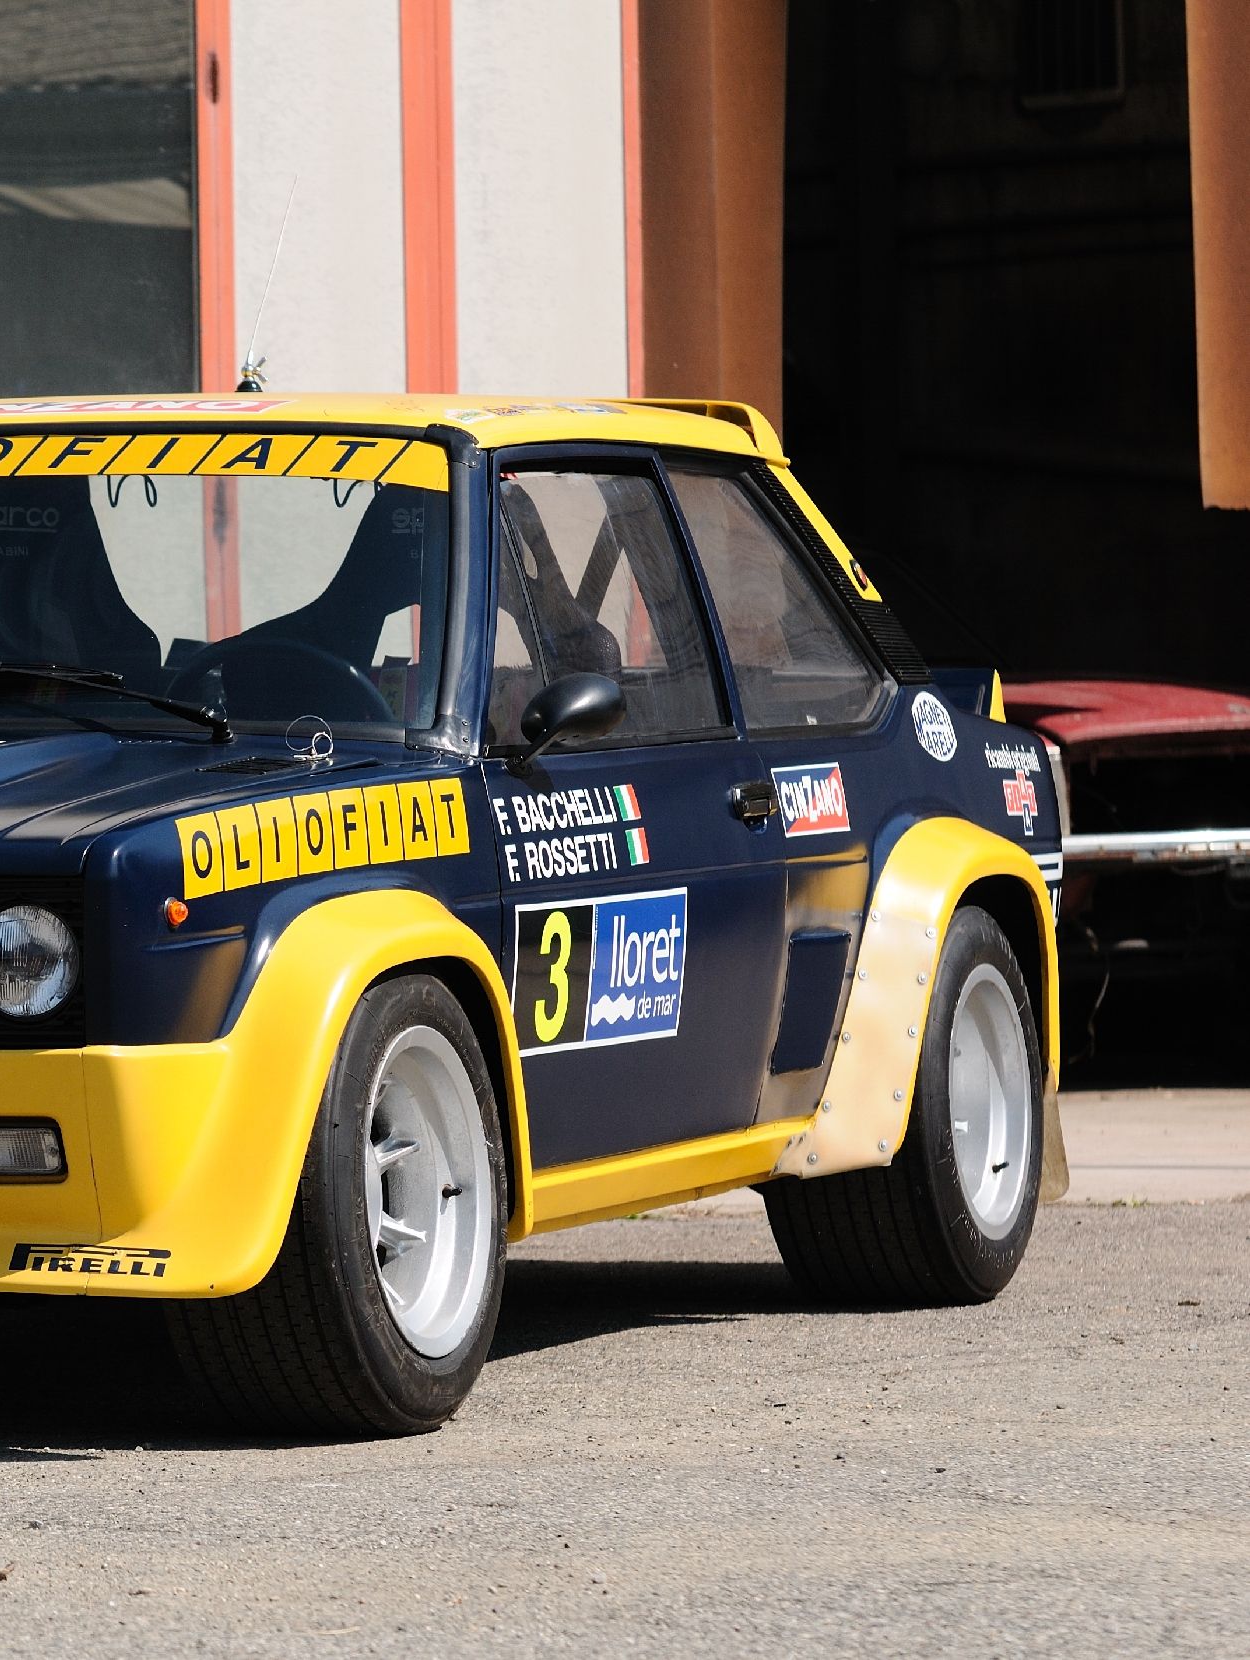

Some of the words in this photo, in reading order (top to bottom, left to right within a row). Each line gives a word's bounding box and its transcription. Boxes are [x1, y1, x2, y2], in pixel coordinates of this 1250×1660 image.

[492, 797, 512, 836] F.
[511, 786, 618, 833] BACCHELLI
[780, 775, 843, 823] CINZANO
[504, 843, 521, 882] F.
[524, 832, 618, 880] ROSSETTI
[609, 914, 681, 989] lloret
[534, 911, 572, 1043] 3
[637, 990, 651, 1019] de
[652, 993, 677, 1018] mar
[8, 1243, 172, 1277] PIRELLI
